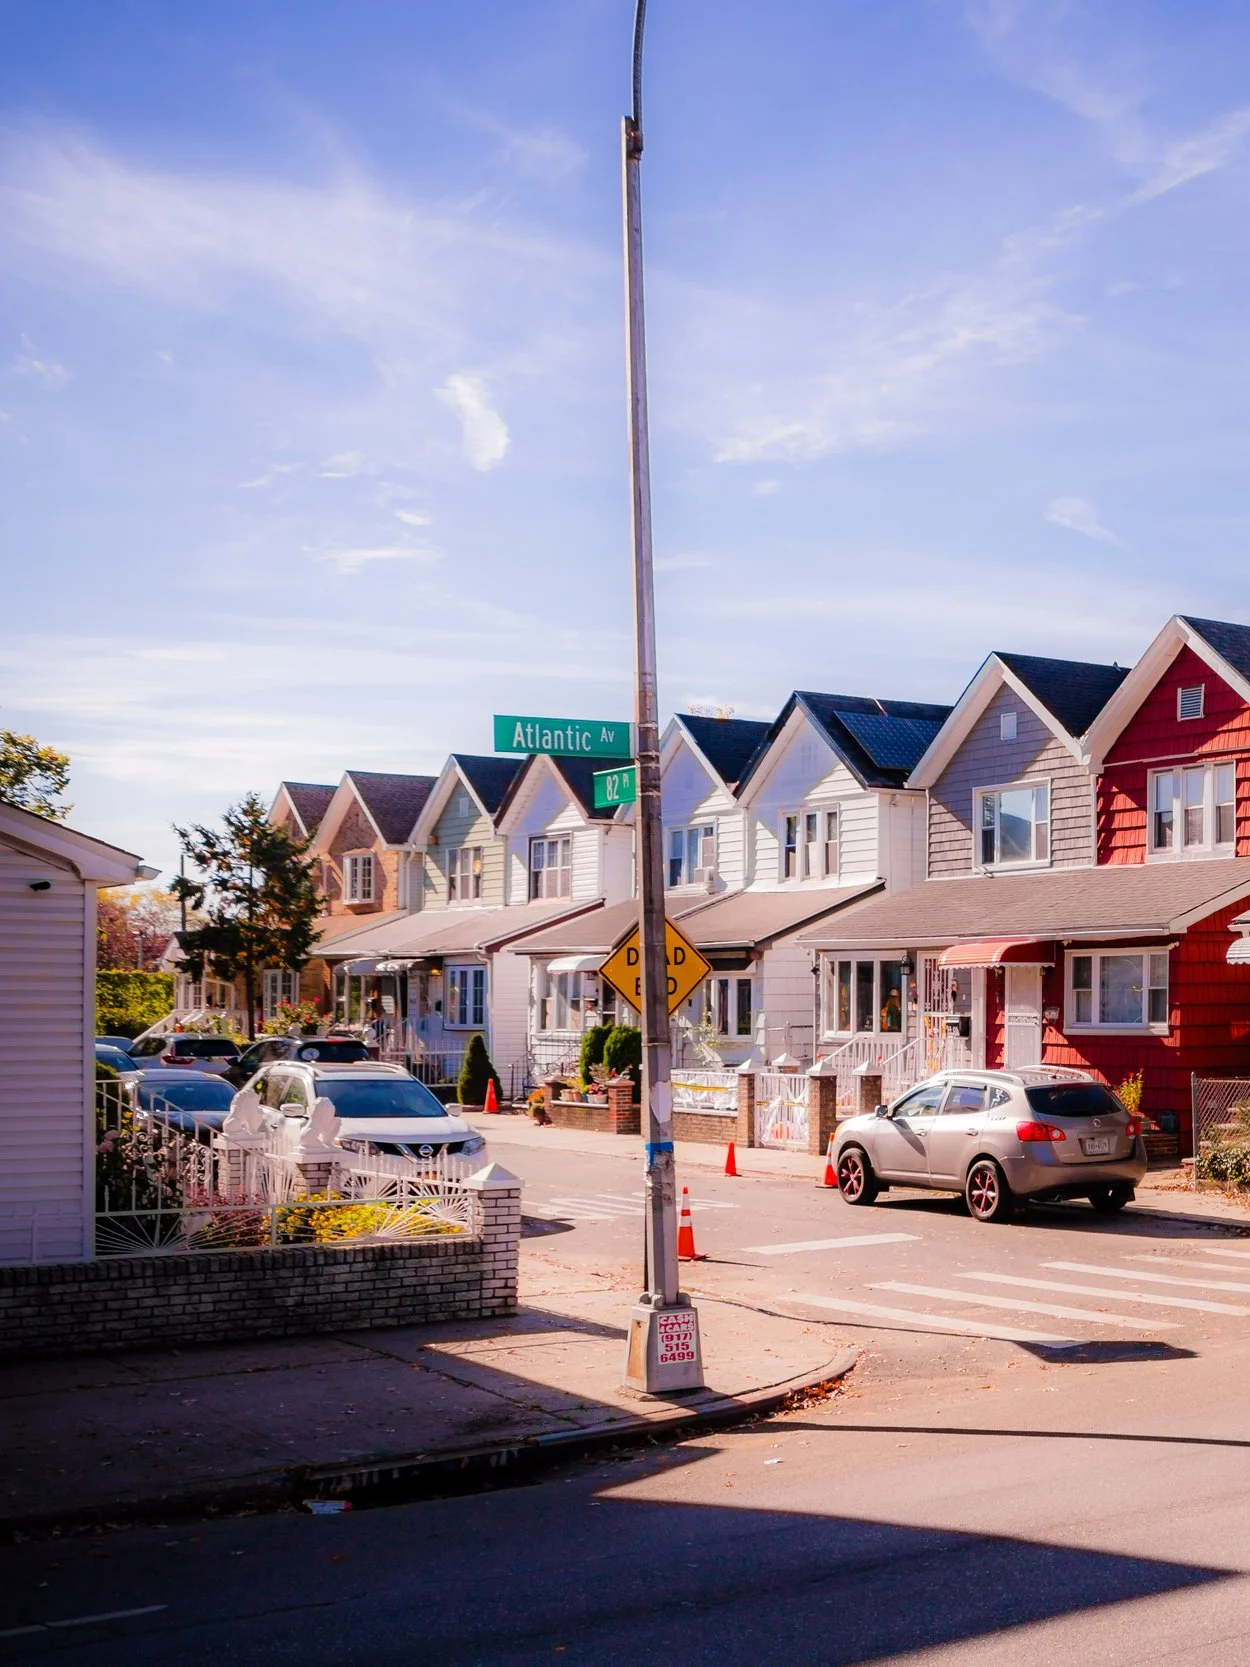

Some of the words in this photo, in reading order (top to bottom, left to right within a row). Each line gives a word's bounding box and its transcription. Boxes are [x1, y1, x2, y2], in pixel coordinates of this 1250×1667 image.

[512, 721, 592, 751] Atlantic
[600, 727, 615, 743] Av
[606, 775, 620, 801] 82
[623, 772, 629, 788] Pl
[627, 947, 686, 966] DD
[635, 977, 678, 996] ED
[661, 1332, 692, 1343] (917)
[660, 1351, 695, 1363] 6499
[665, 1342, 690, 1353] 515
